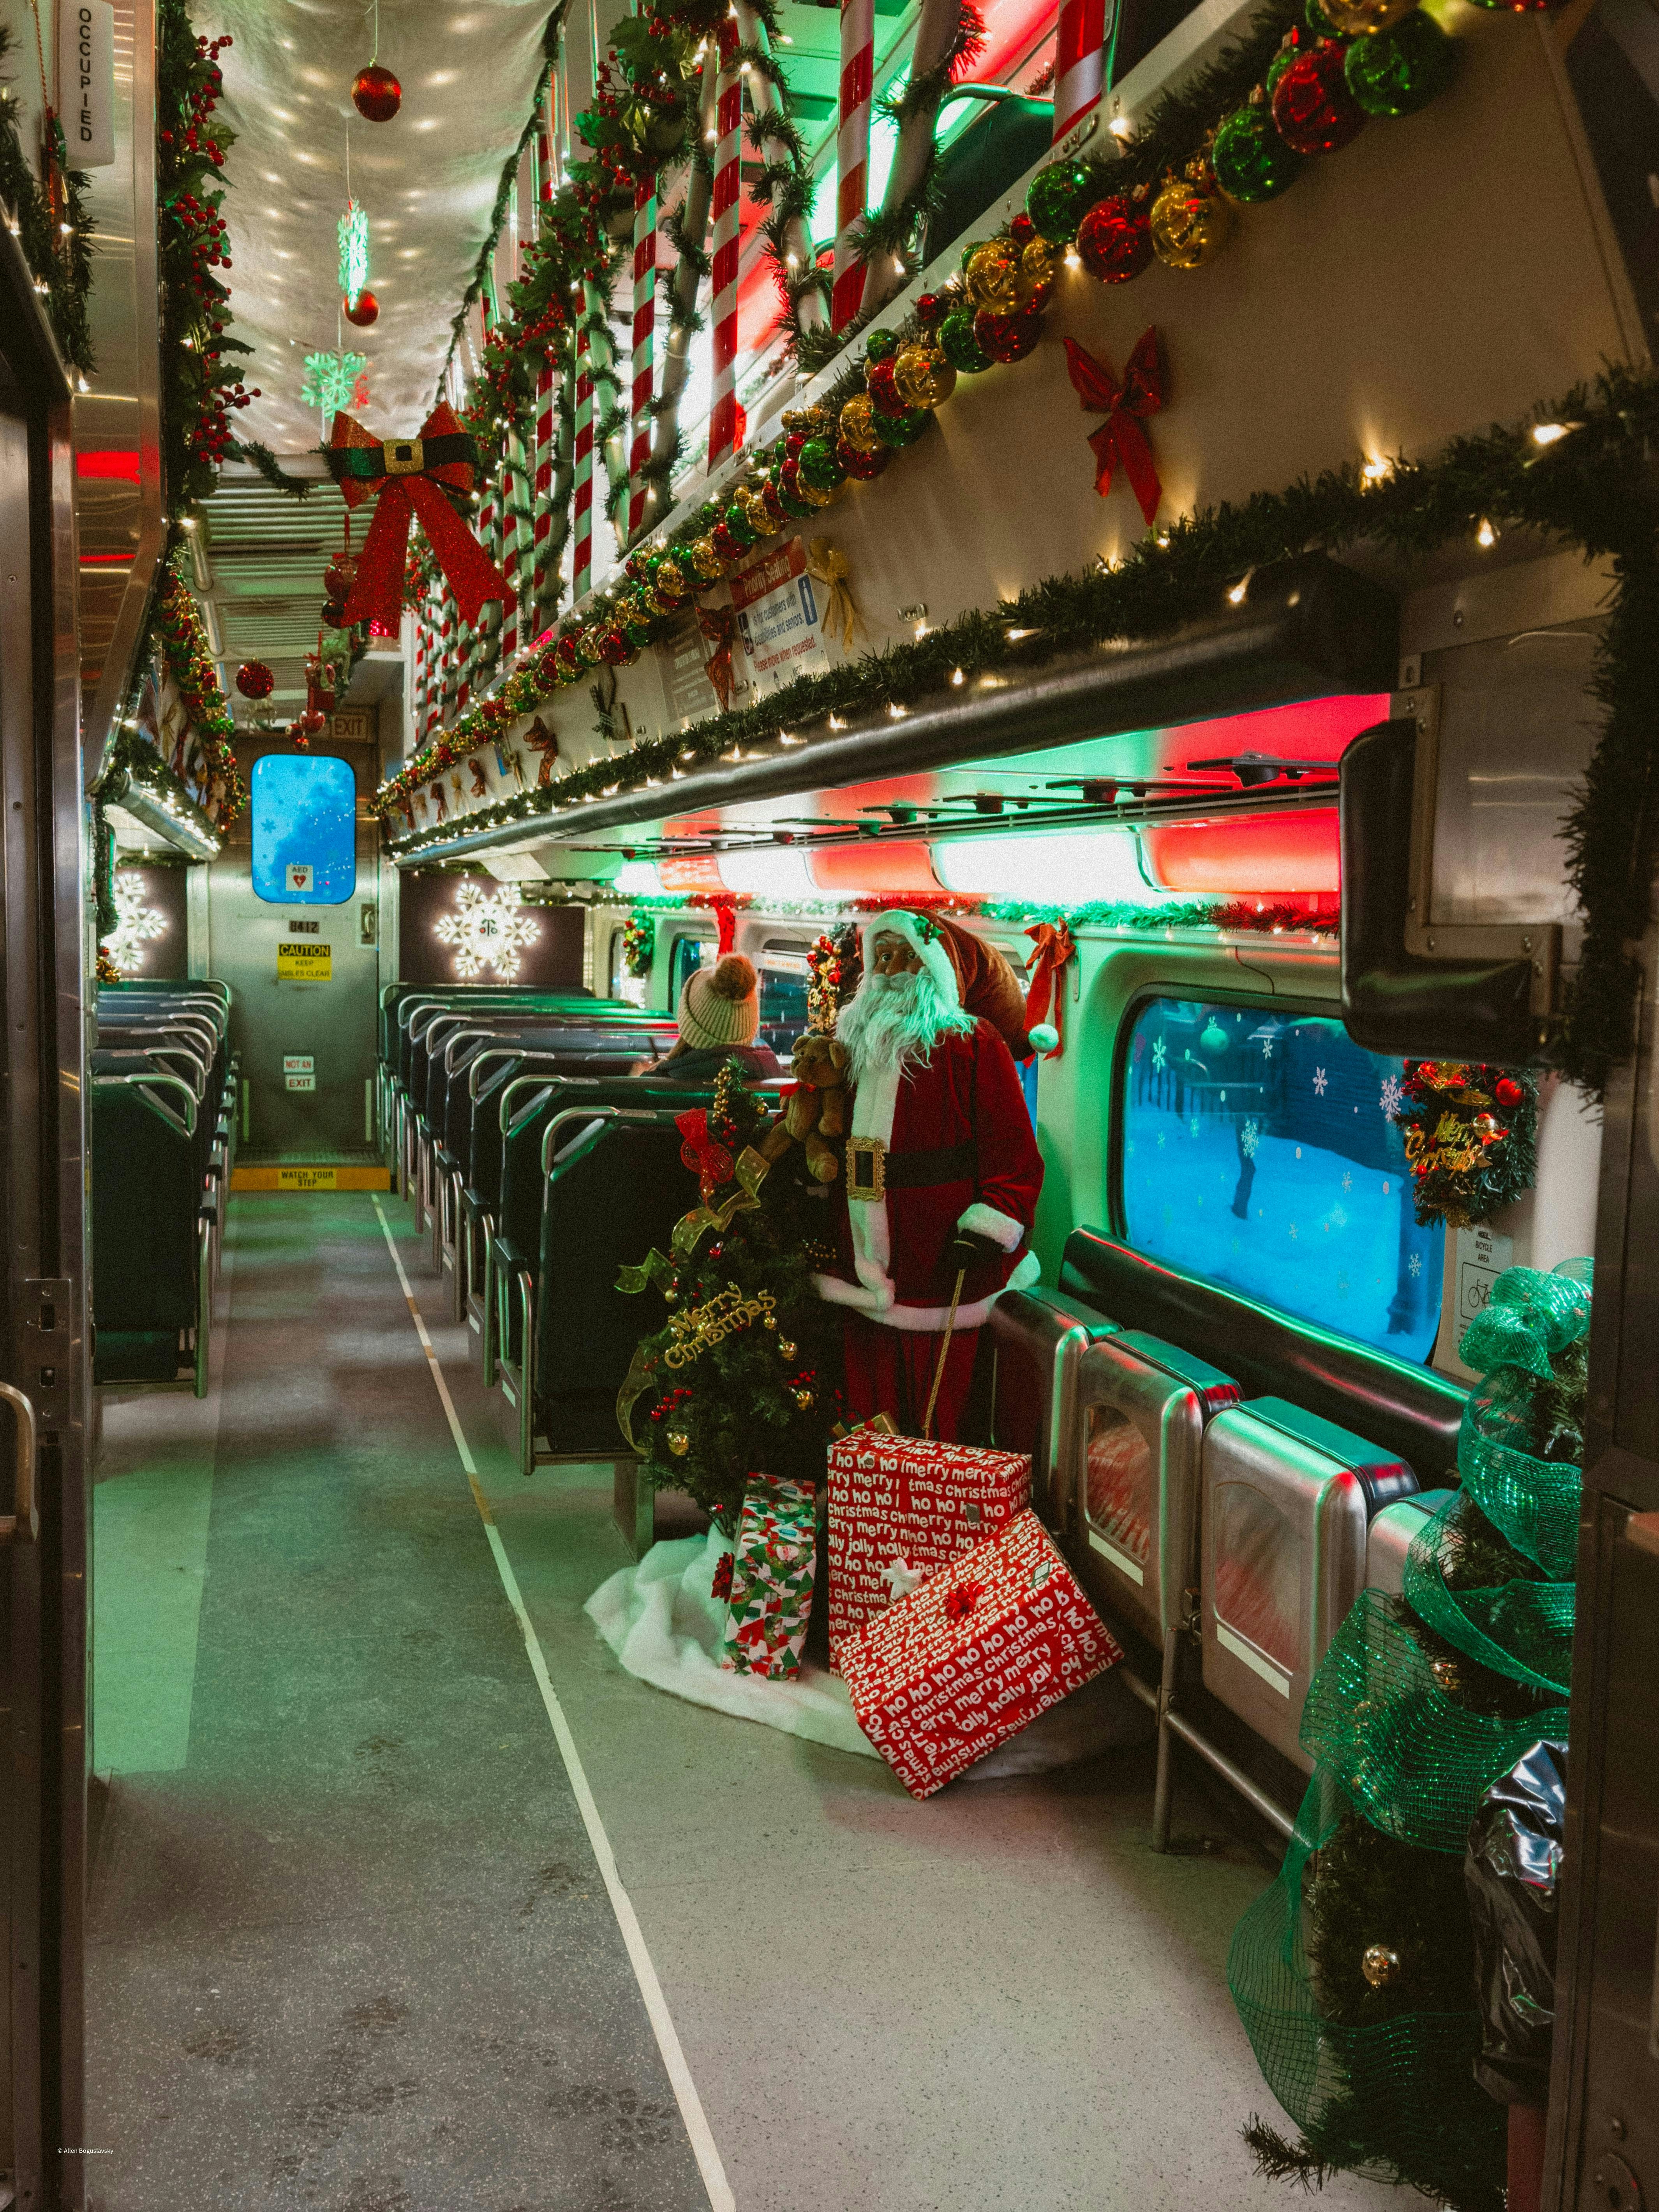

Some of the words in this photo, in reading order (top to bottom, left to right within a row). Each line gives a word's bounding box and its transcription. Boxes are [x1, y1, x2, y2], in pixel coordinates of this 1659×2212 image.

[79, 8, 92, 142] OCCUPIED
[743, 570, 767, 598] Priority
[765, 556, 792, 584] Seating
[786, 591, 797, 608] with
[779, 647, 792, 662] when
[335, 718, 363, 735] EXIT
[280, 945, 329, 955] CAUTION
[286, 1060, 300, 1068] NOT
[302, 1060, 311, 1068] AN
[289, 1079, 311, 1087] EXIT
[1475, 1241, 1493, 1253] BICYCLE
[1478, 1253, 1489, 1263] AREA
[668, 1281, 742, 1334] Merry
[665, 1289, 776, 1368] Christmas
[880, 1457, 897, 1471] ho
[853, 1472, 893, 1491] merry
[906, 1461, 949, 1481] merry
[952, 1467, 996, 1487] merry
[852, 1489, 871, 1503] ho
[874, 1491, 892, 1506] ho
[945, 1484, 1011, 1499] christmas
[911, 1496, 931, 1510] ho
[936, 1498, 955, 1513] ho
[983, 1503, 1005, 1518] ho
[857, 1521, 897, 1540] merry
[931, 1532, 952, 1546] ho
[956, 1534, 974, 1550] ho
[844, 1555, 862, 1571] ho
[865, 1559, 885, 1572] ho
[848, 1604, 864, 1619] ho
[883, 1696, 908, 1718] ho
[908, 1682, 932, 1703] ho
[931, 1664, 956, 1687] ho
[955, 1648, 980, 1669] ho
[980, 1633, 1004, 1655] ho
[1002, 1615, 1028, 1637] ho
[1028, 1597, 1053, 1618] ho
[911, 1667, 984, 1720] christmas
[984, 1617, 1056, 1673] christmas
[954, 1675, 1003, 1711] merry
[1004, 1643, 1051, 1681] merry
[987, 1683, 1026, 1713] holly
